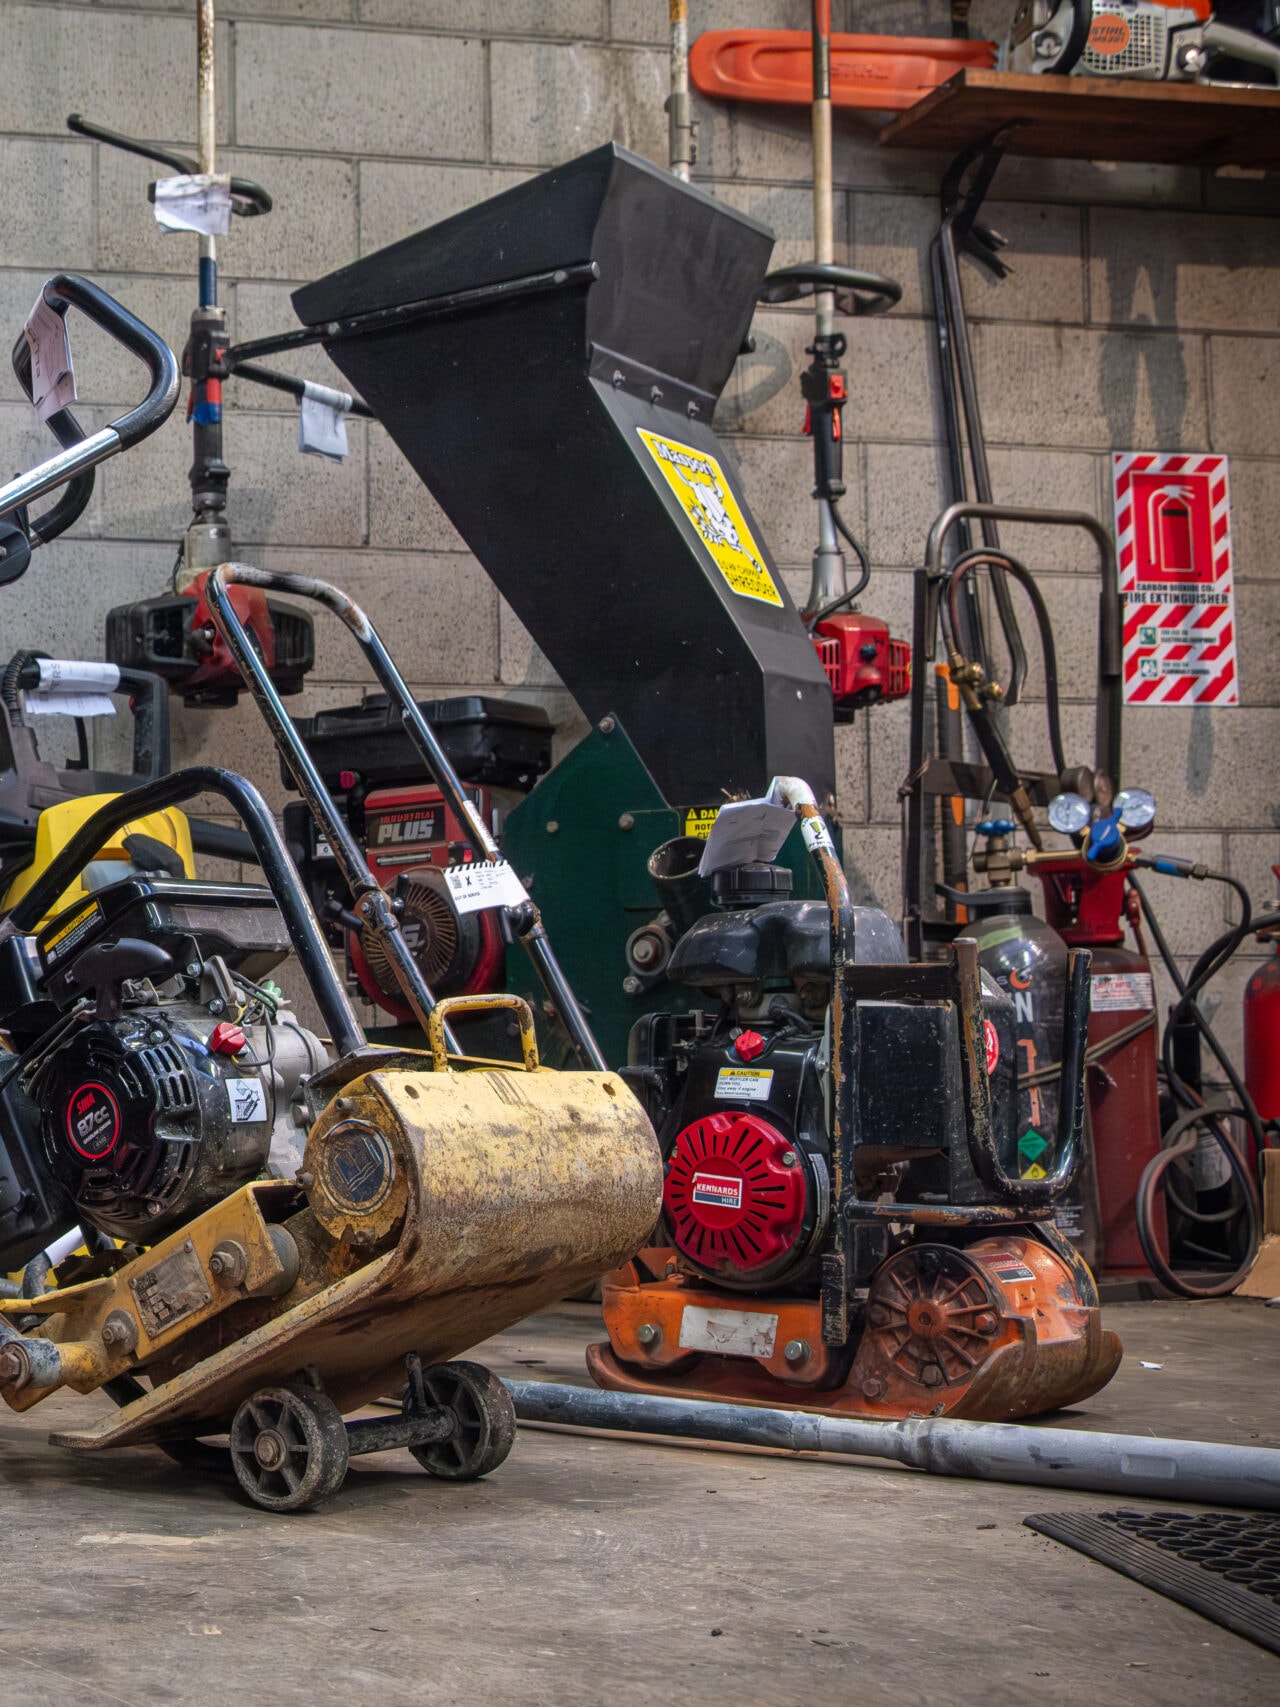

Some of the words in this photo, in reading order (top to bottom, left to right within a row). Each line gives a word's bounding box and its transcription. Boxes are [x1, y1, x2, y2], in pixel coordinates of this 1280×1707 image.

[1150, 592, 1229, 604] EXTINGUISHER
[381, 810, 435, 824] INDUSTRIAL
[377, 819, 435, 844] PLUS
[64, 913, 85, 934] CAUTION
[696, 1183, 738, 1196] KENNARDS
[721, 1196, 738, 1206] HIRE
